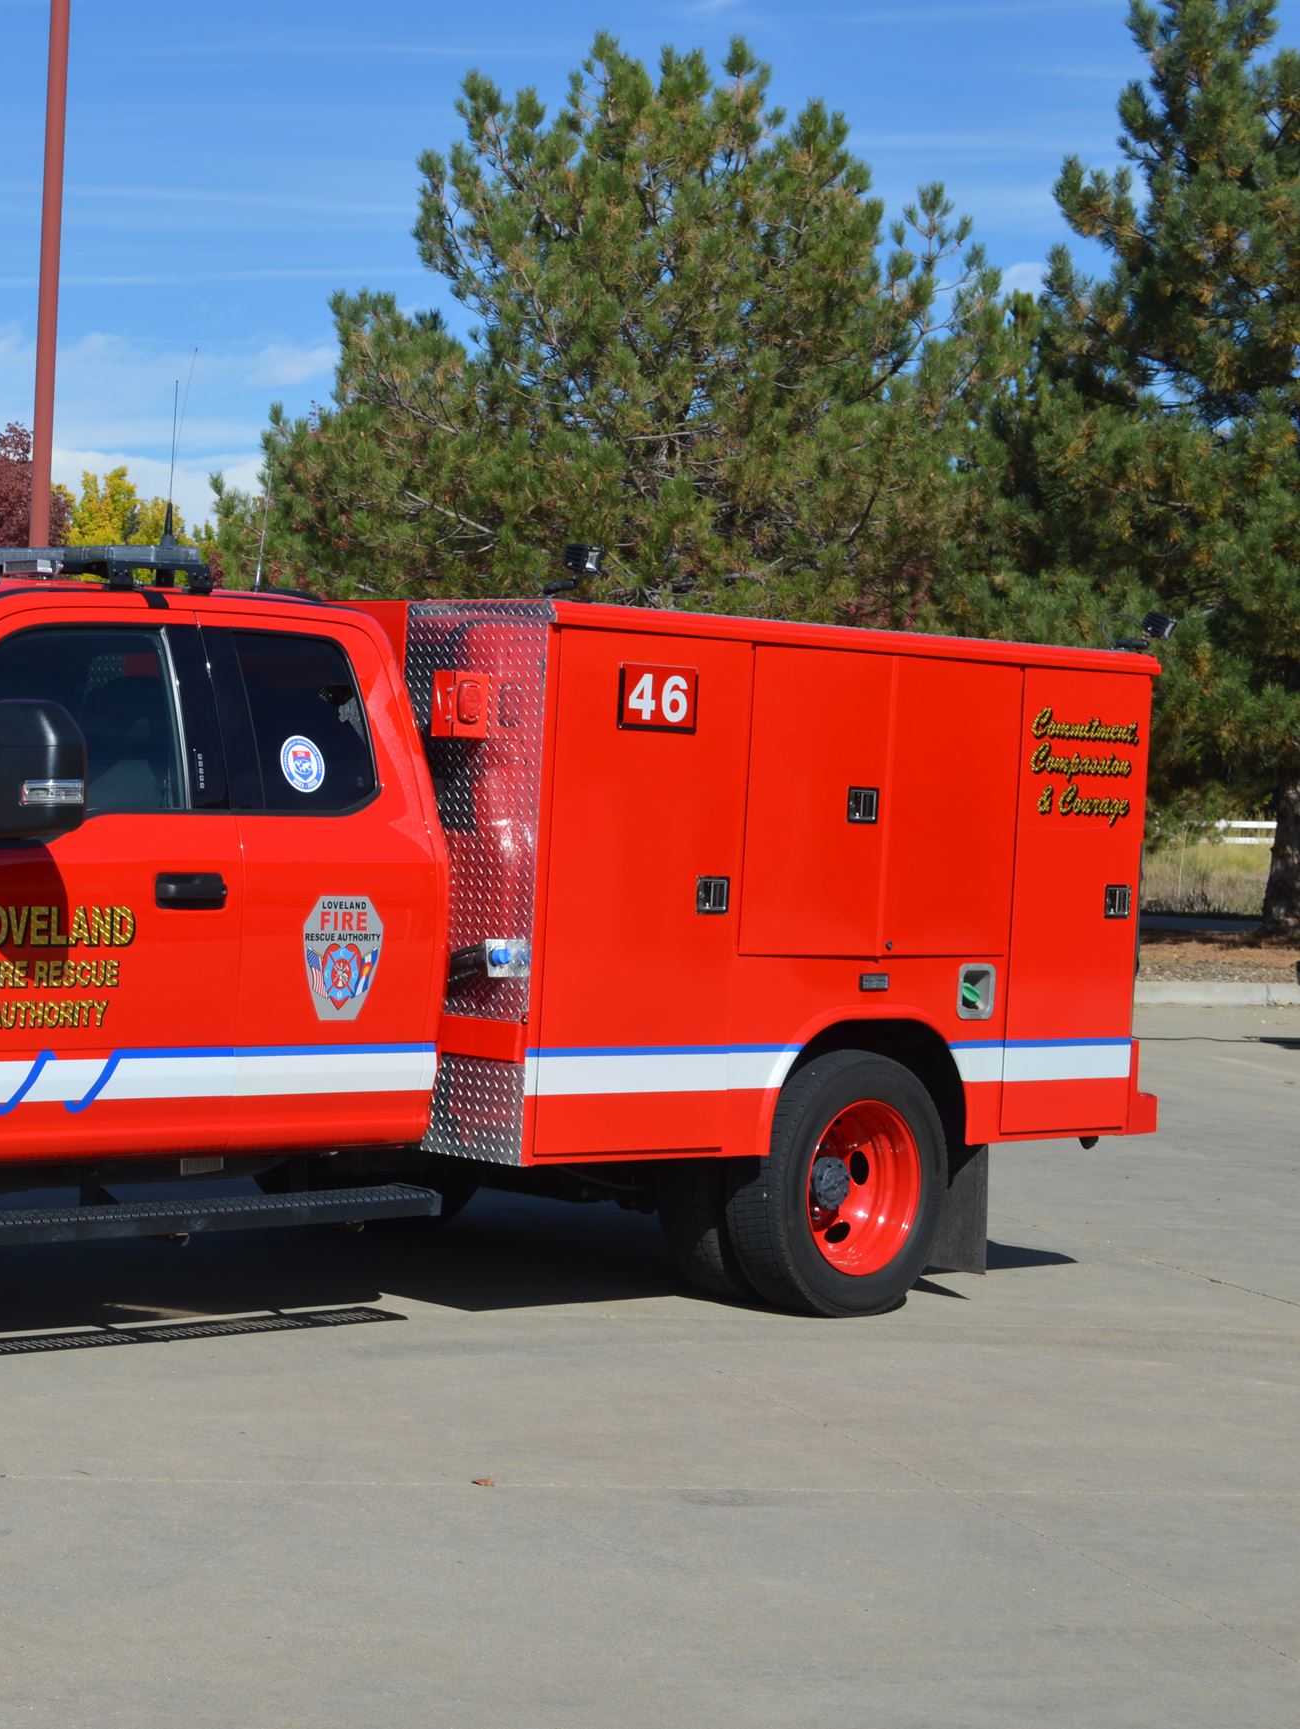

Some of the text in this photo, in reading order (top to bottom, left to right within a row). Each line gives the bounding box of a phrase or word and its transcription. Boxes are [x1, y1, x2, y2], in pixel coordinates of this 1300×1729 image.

[628, 673, 688, 723] 46
[1032, 706, 1139, 747] Commitment,
[1030, 742, 1132, 783] Compassion
[1037, 784, 1130, 827] & Courage
[320, 911, 368, 932] FIRE
[322, 901, 367, 909] LOVELAND
[305, 933, 381, 941] RESCUE AUTHORITY
[33, 959, 120, 988] RESCUE
